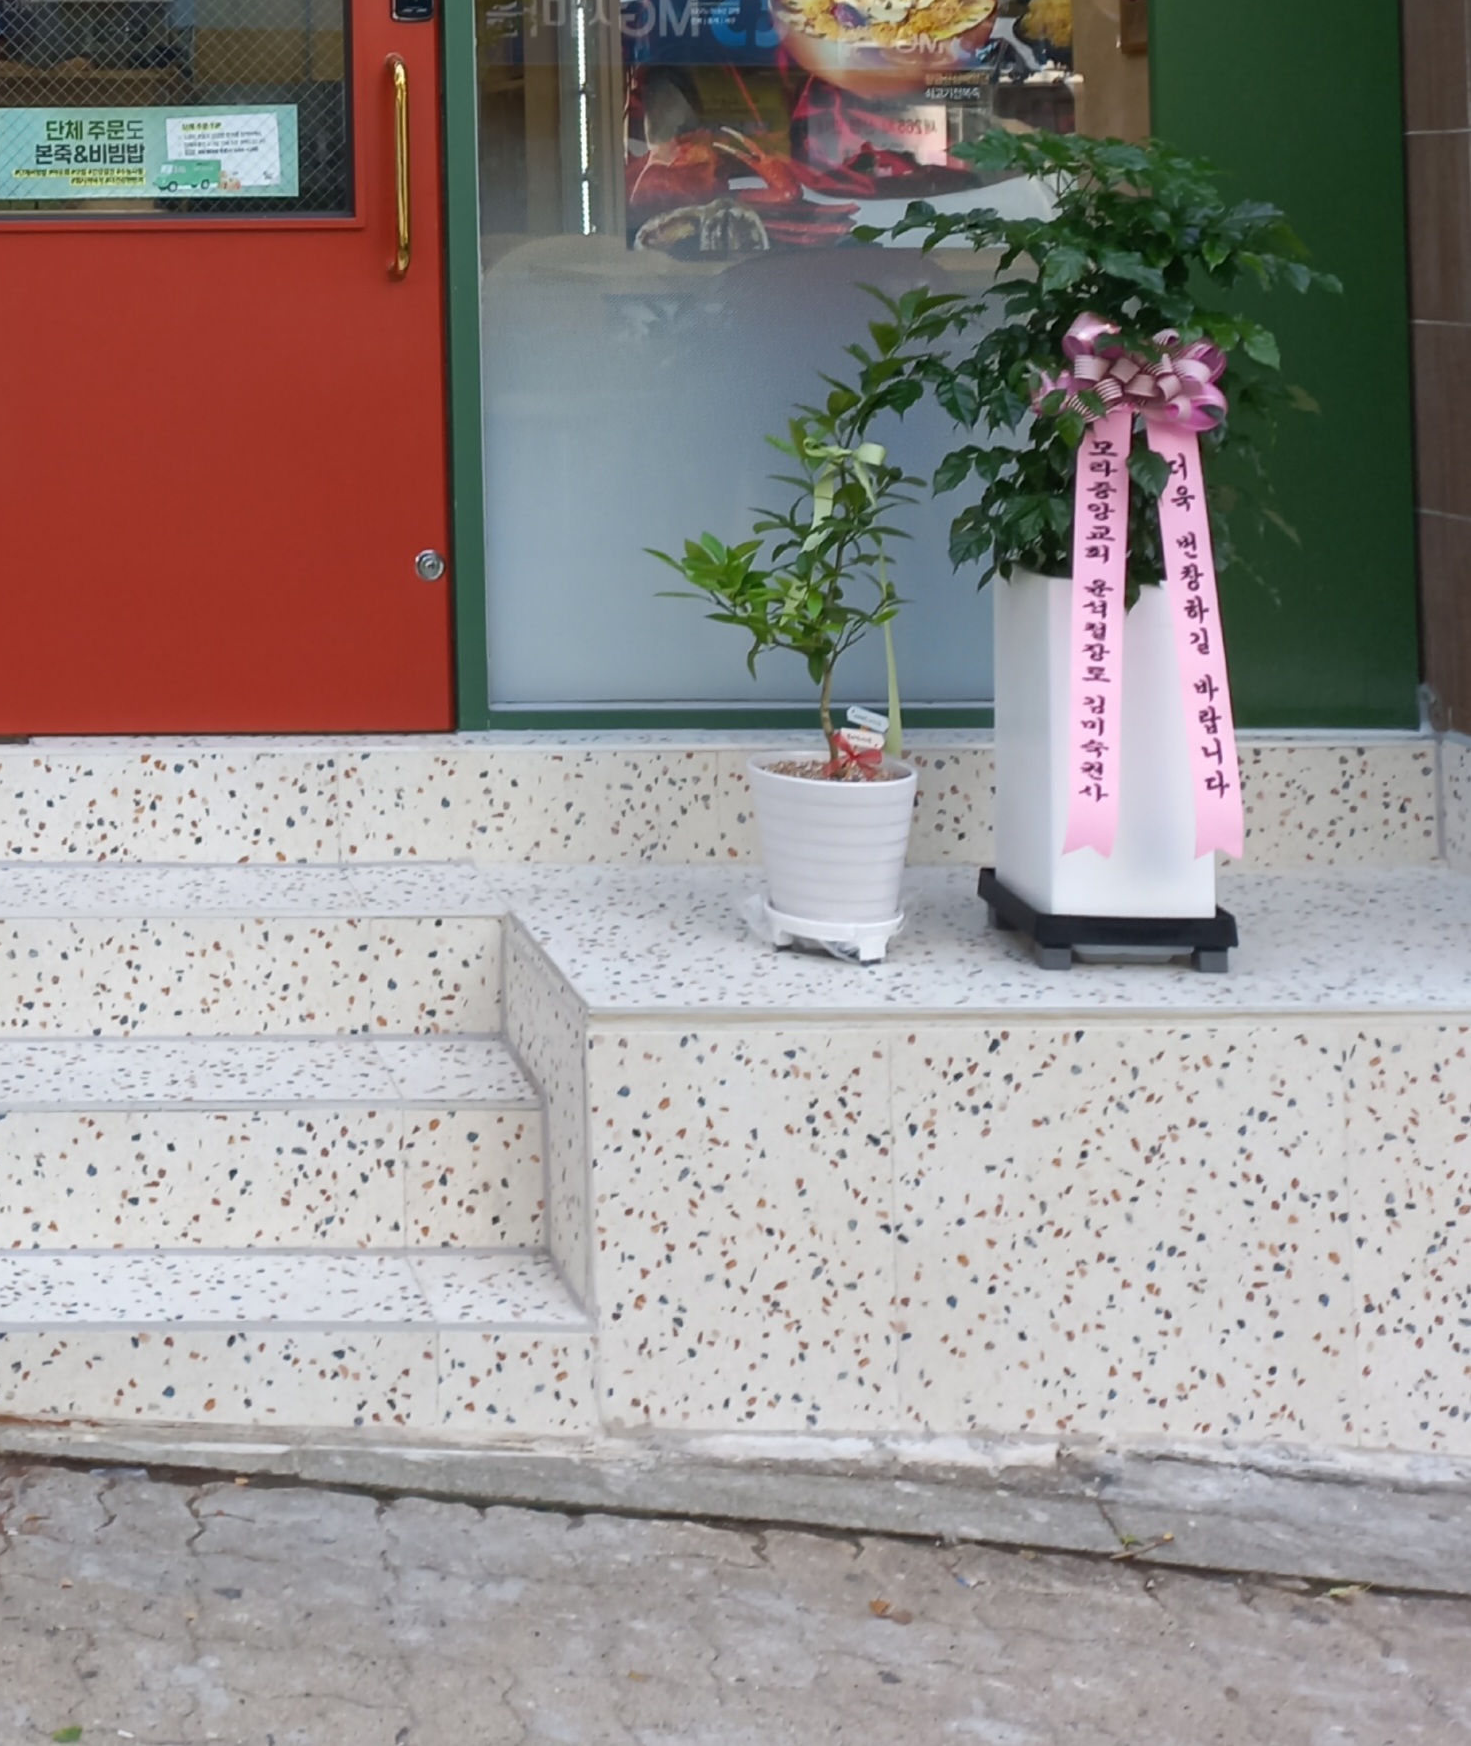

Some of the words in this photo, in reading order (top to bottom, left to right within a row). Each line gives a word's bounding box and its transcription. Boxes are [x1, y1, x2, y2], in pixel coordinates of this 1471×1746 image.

[34, 143, 145, 166] 본죽&비빔밥
[46, 119, 84, 141] 단체
[87, 118, 144, 141] 주문도
[1083, 440, 1119, 564] 모라중앙교회
[1168, 451, 1196, 512] 더욱
[1175, 530, 1211, 656] 번창하길
[1193, 672, 1231, 800] 바랍니다
